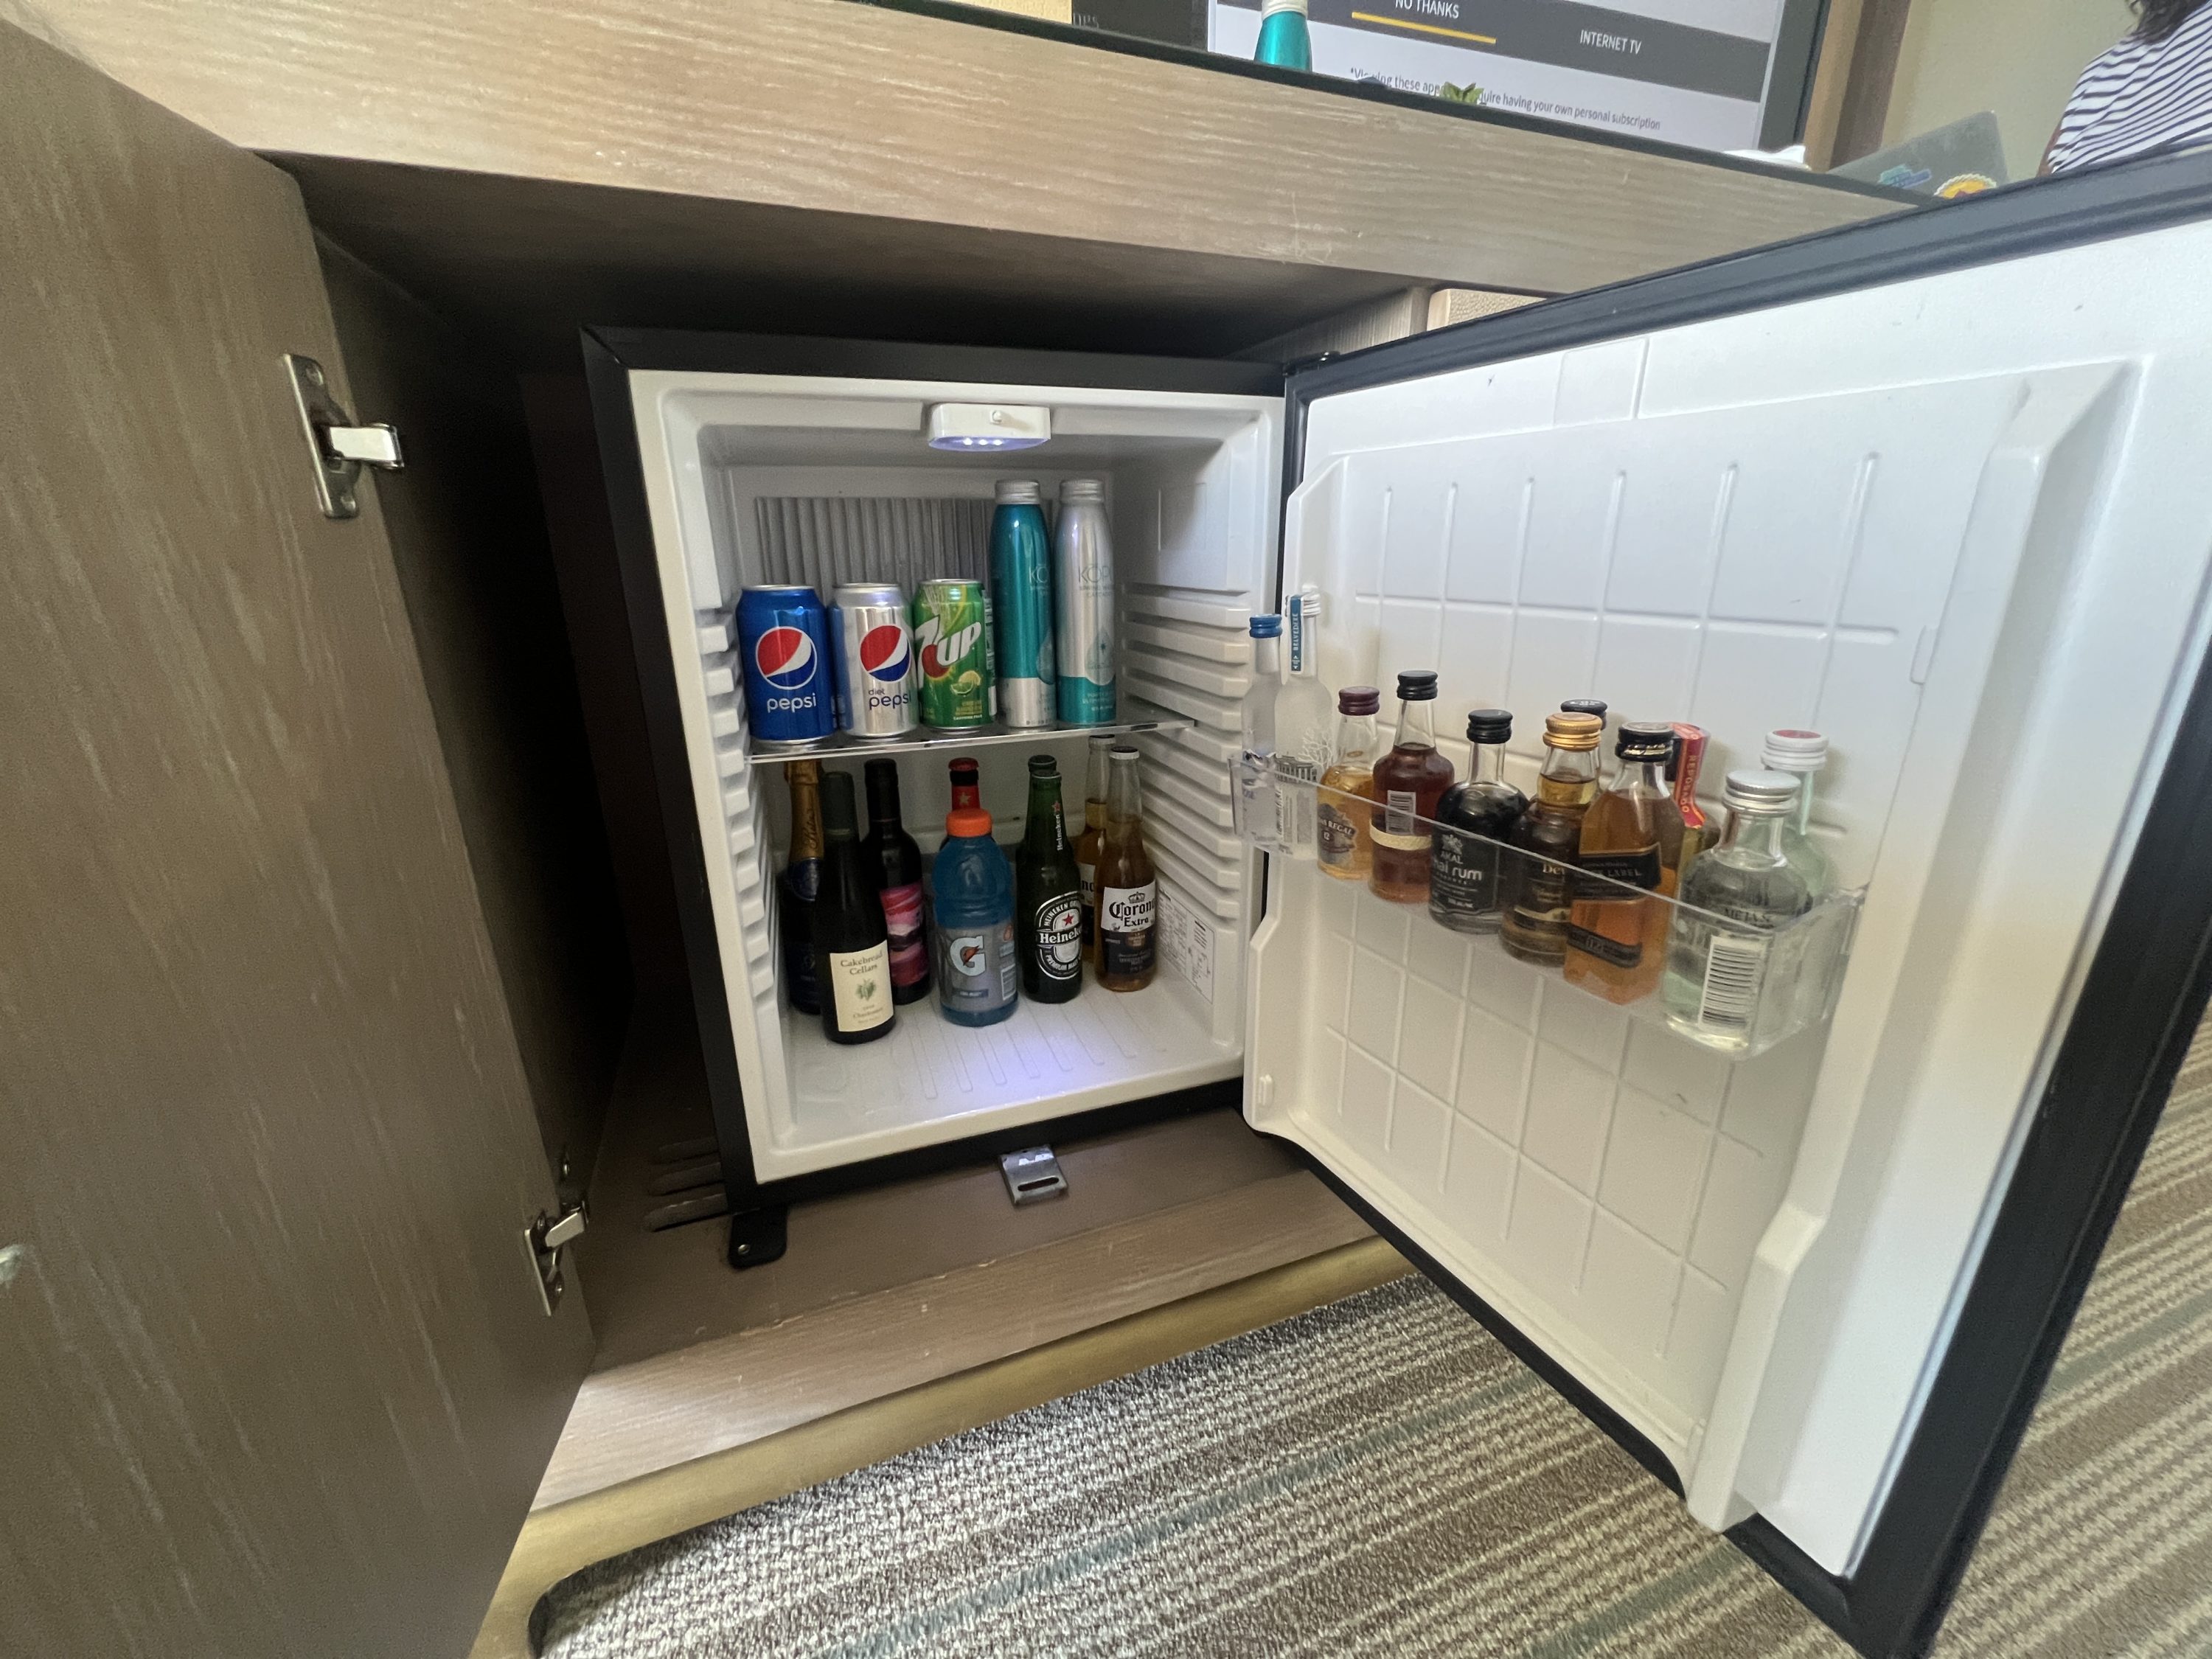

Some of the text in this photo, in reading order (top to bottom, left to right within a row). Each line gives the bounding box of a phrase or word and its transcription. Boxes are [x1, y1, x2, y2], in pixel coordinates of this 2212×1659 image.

[1396, 0, 1459, 18] NO THANKS
[1579, 29, 1643, 55] INTERNET TV
[1395, 74, 1420, 90] these
[1503, 92, 1531, 111] having
[1534, 100, 1554, 113] your
[1555, 105, 1573, 116] own
[1575, 107, 1610, 122] personal
[1612, 114, 1660, 131] subscription
[868, 687, 886, 696] diet
[767, 692, 817, 714] pepsi
[869, 692, 912, 712] pepsi
[1680, 754, 1698, 813] REPOSADO
[1055, 813, 1063, 850] Heineken
[1328, 820, 1353, 835] REGAL
[1452, 866, 1483, 881] rum
[1043, 902, 1068, 926] HEINEKEN
[1124, 917, 1149, 928] Extra
[840, 949, 883, 967] Cakebread
[950, 935, 987, 976] G
[849, 963, 878, 975] Cellars
